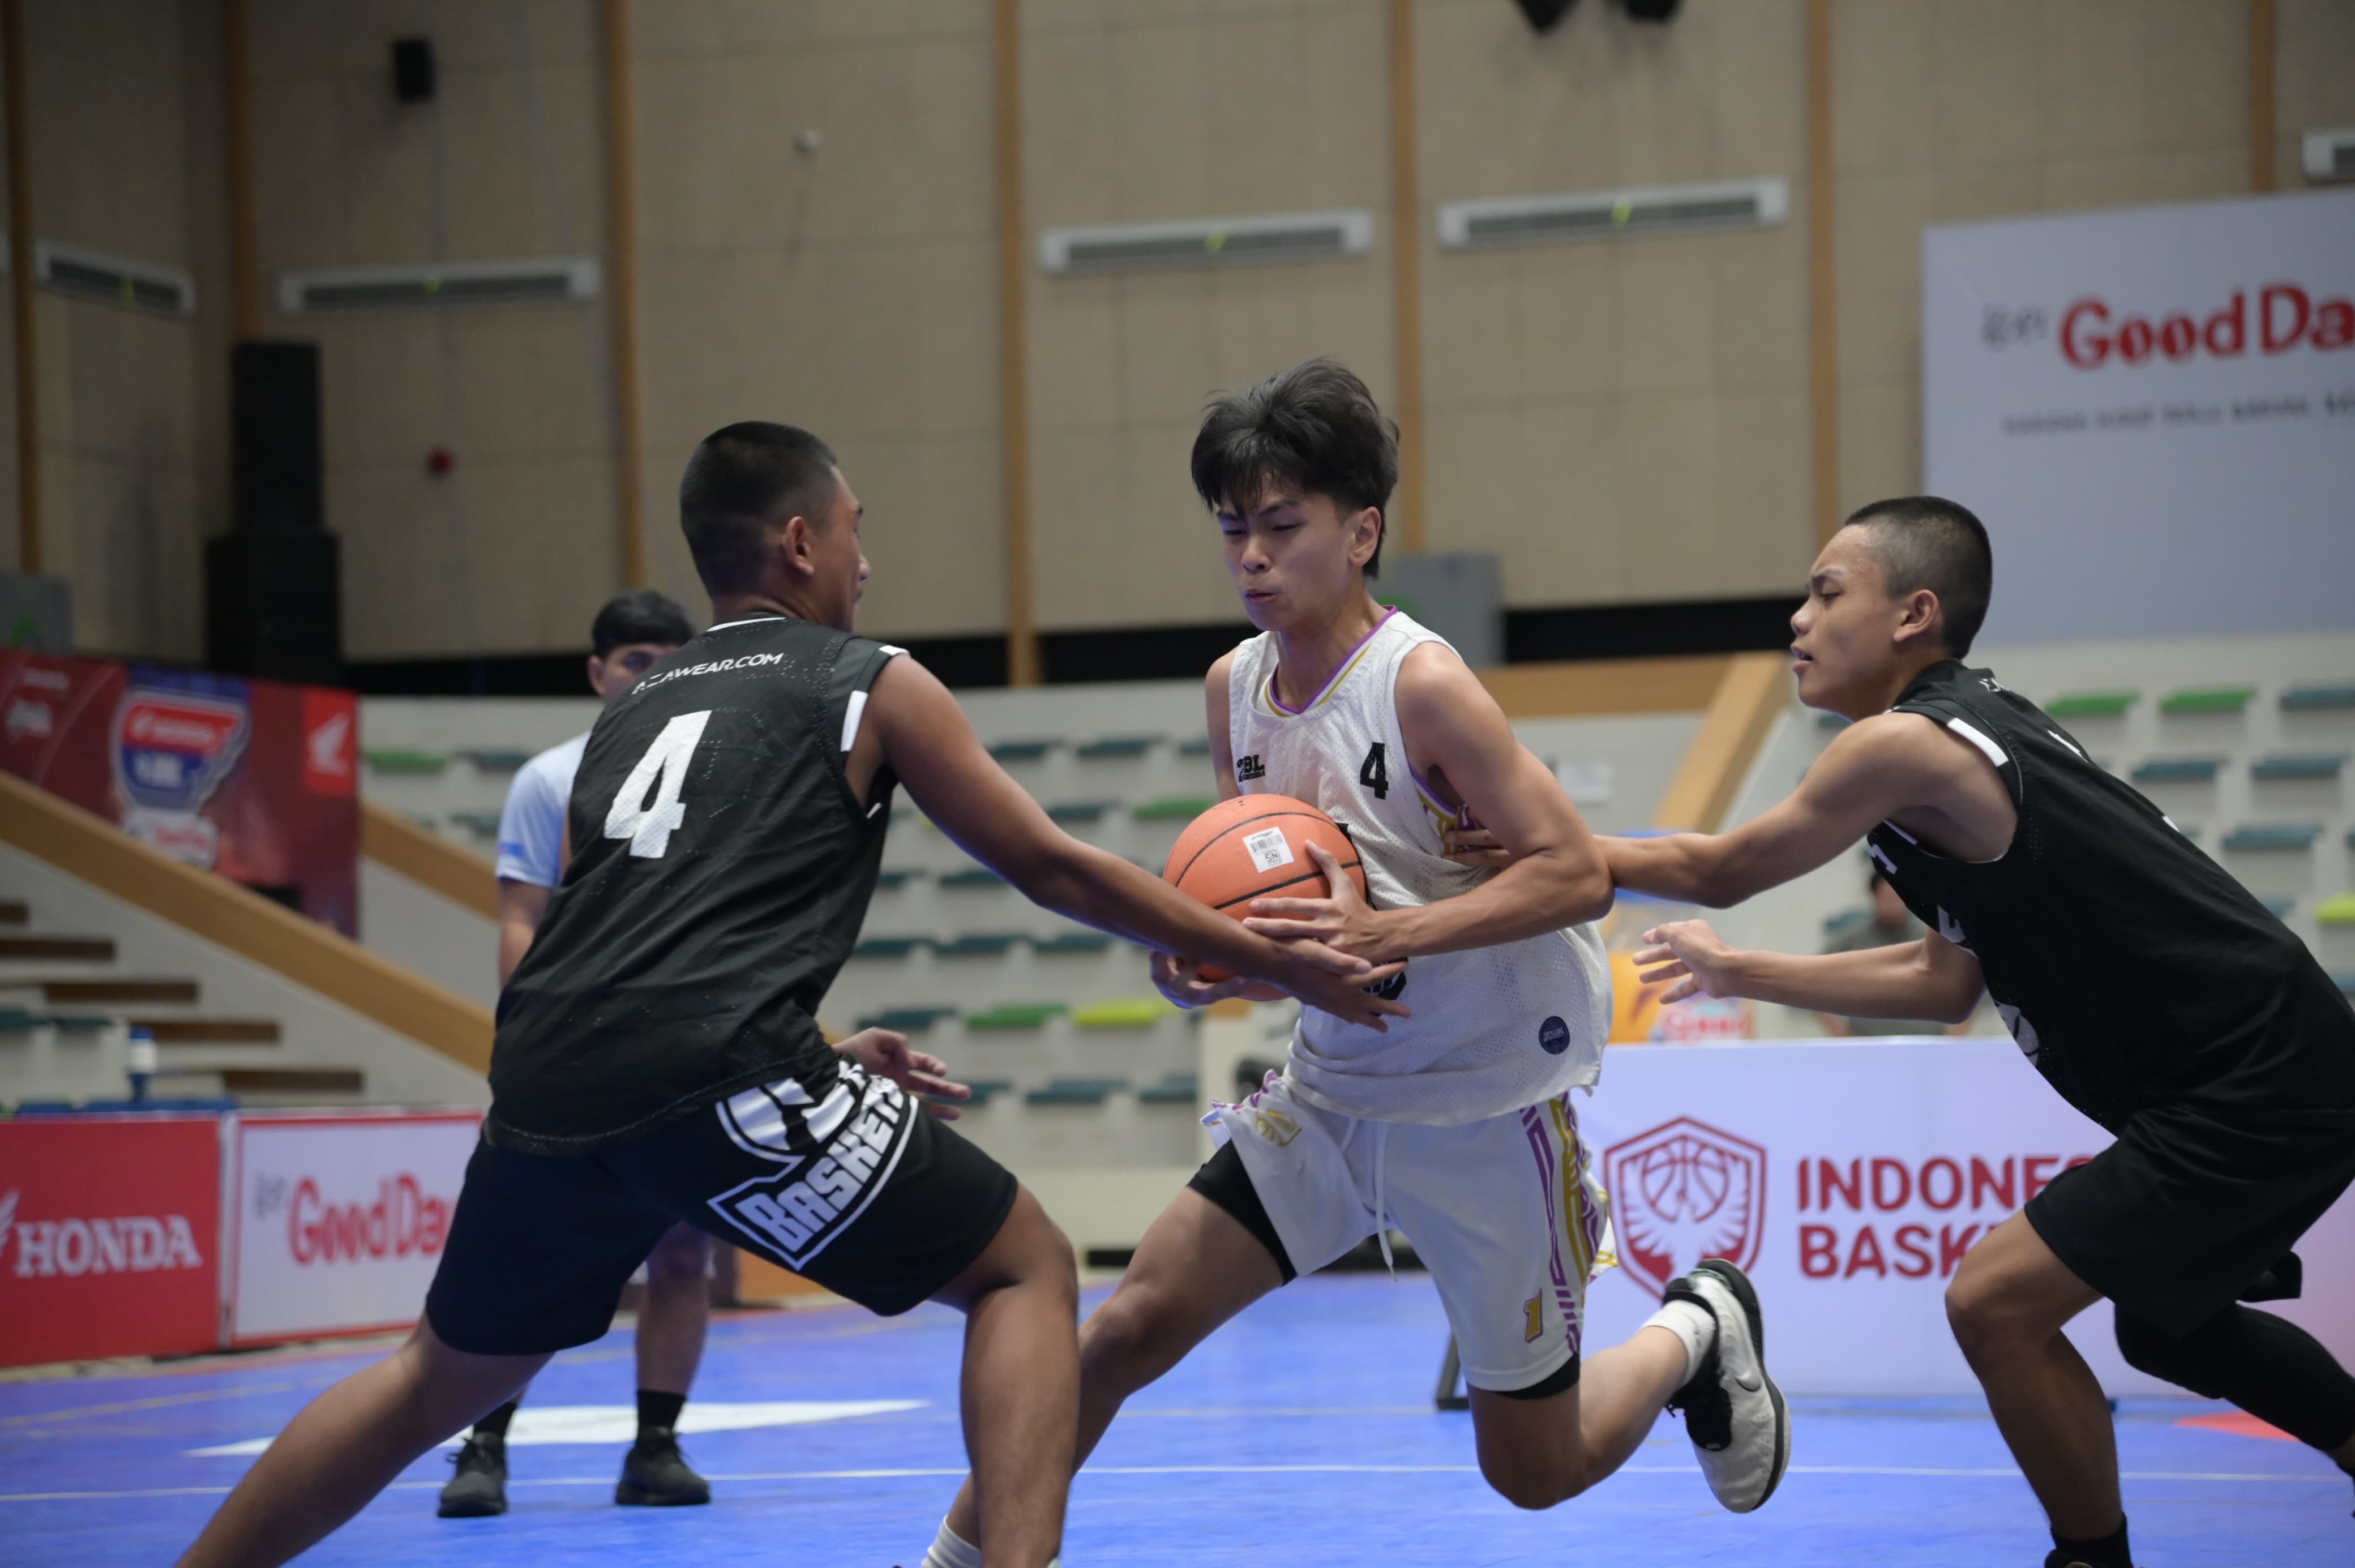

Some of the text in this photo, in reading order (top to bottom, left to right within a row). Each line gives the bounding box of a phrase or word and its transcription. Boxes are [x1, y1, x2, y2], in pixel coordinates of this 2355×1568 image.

[603, 710, 712, 858] 4
[1360, 742, 1389, 800] 4
[14, 1215, 202, 1278] HONDA
[1799, 1224, 1997, 1280] BASK
[1523, 1288, 1543, 1344] 1
